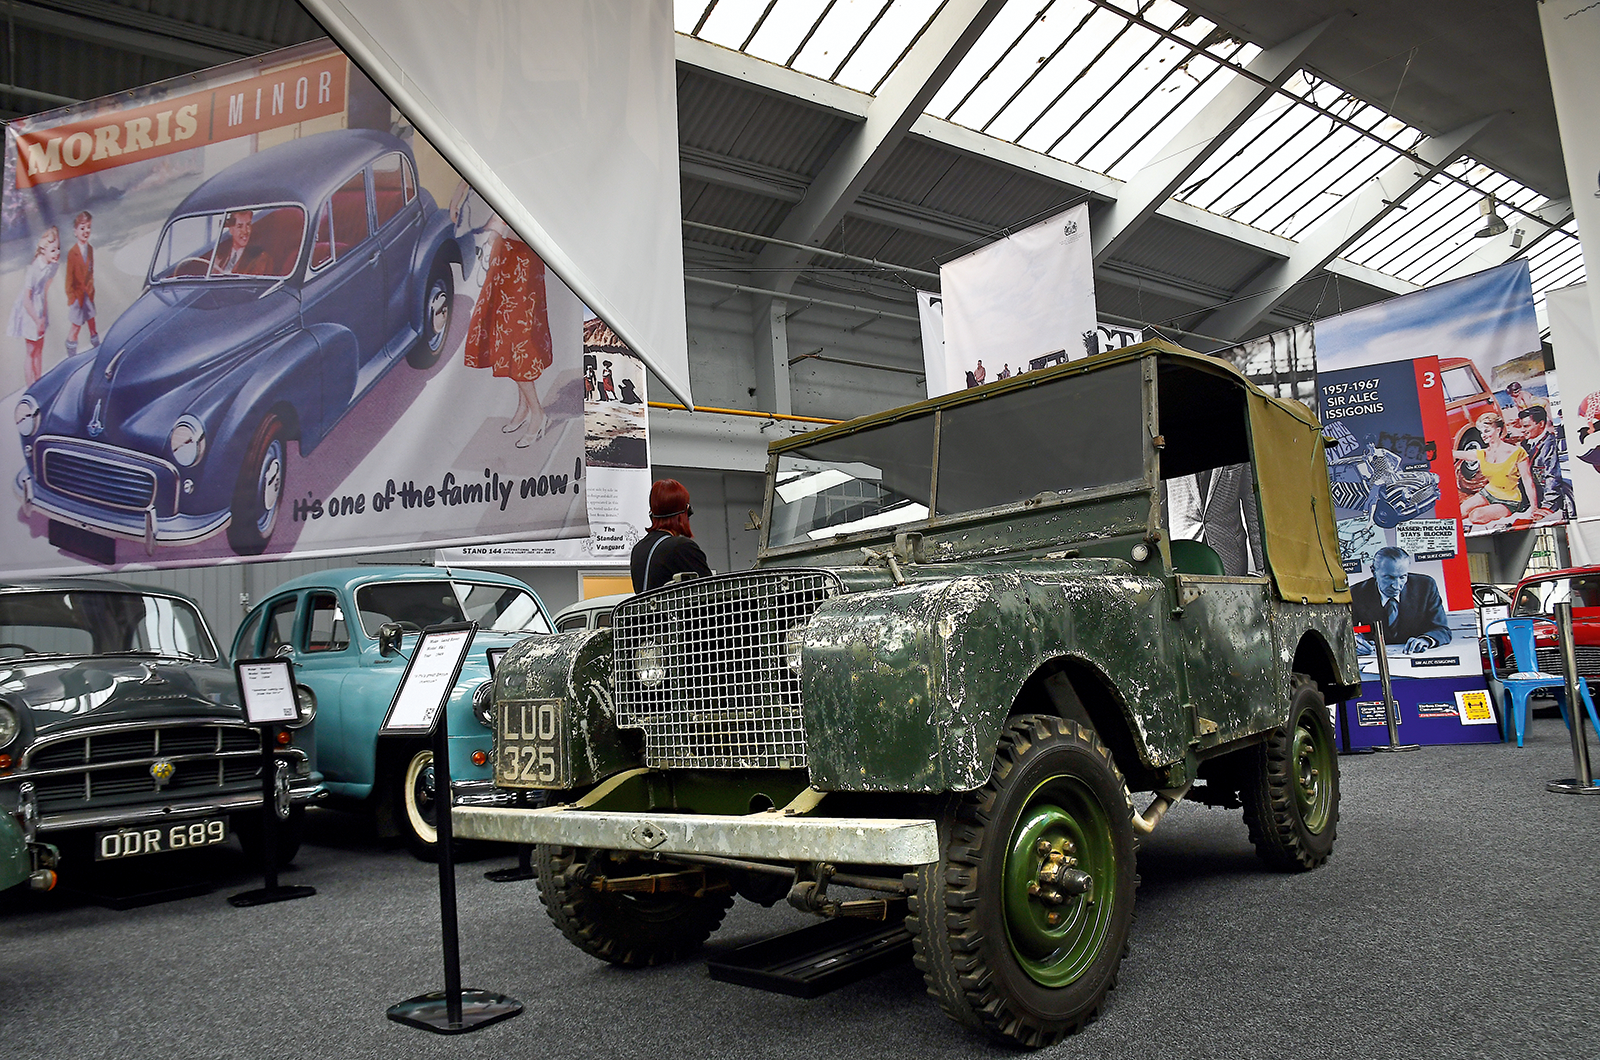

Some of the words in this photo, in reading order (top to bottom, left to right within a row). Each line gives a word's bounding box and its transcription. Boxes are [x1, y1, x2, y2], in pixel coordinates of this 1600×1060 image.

[28, 104, 199, 176] MORRIS
[228, 70, 332, 127] MINOR
[1322, 378, 1381, 396] 1957-1967
[1423, 371, 1435, 388] 3
[1325, 402, 1384, 420] ISSIGONIS
[1327, 396, 1346, 407] SIR
[1348, 391, 1379, 405] ALEC
[293, 491, 325, 522] It's
[328, 493, 366, 517] one
[372, 479, 396, 512] of
[397, 480, 435, 510] the
[436, 471, 515, 511] family
[596, 543, 625, 551] Vanguard
[504, 704, 555, 740] LUO
[503, 746, 555, 782] 325
[102, 828, 162, 858] ODR
[169, 820, 225, 849] 689
